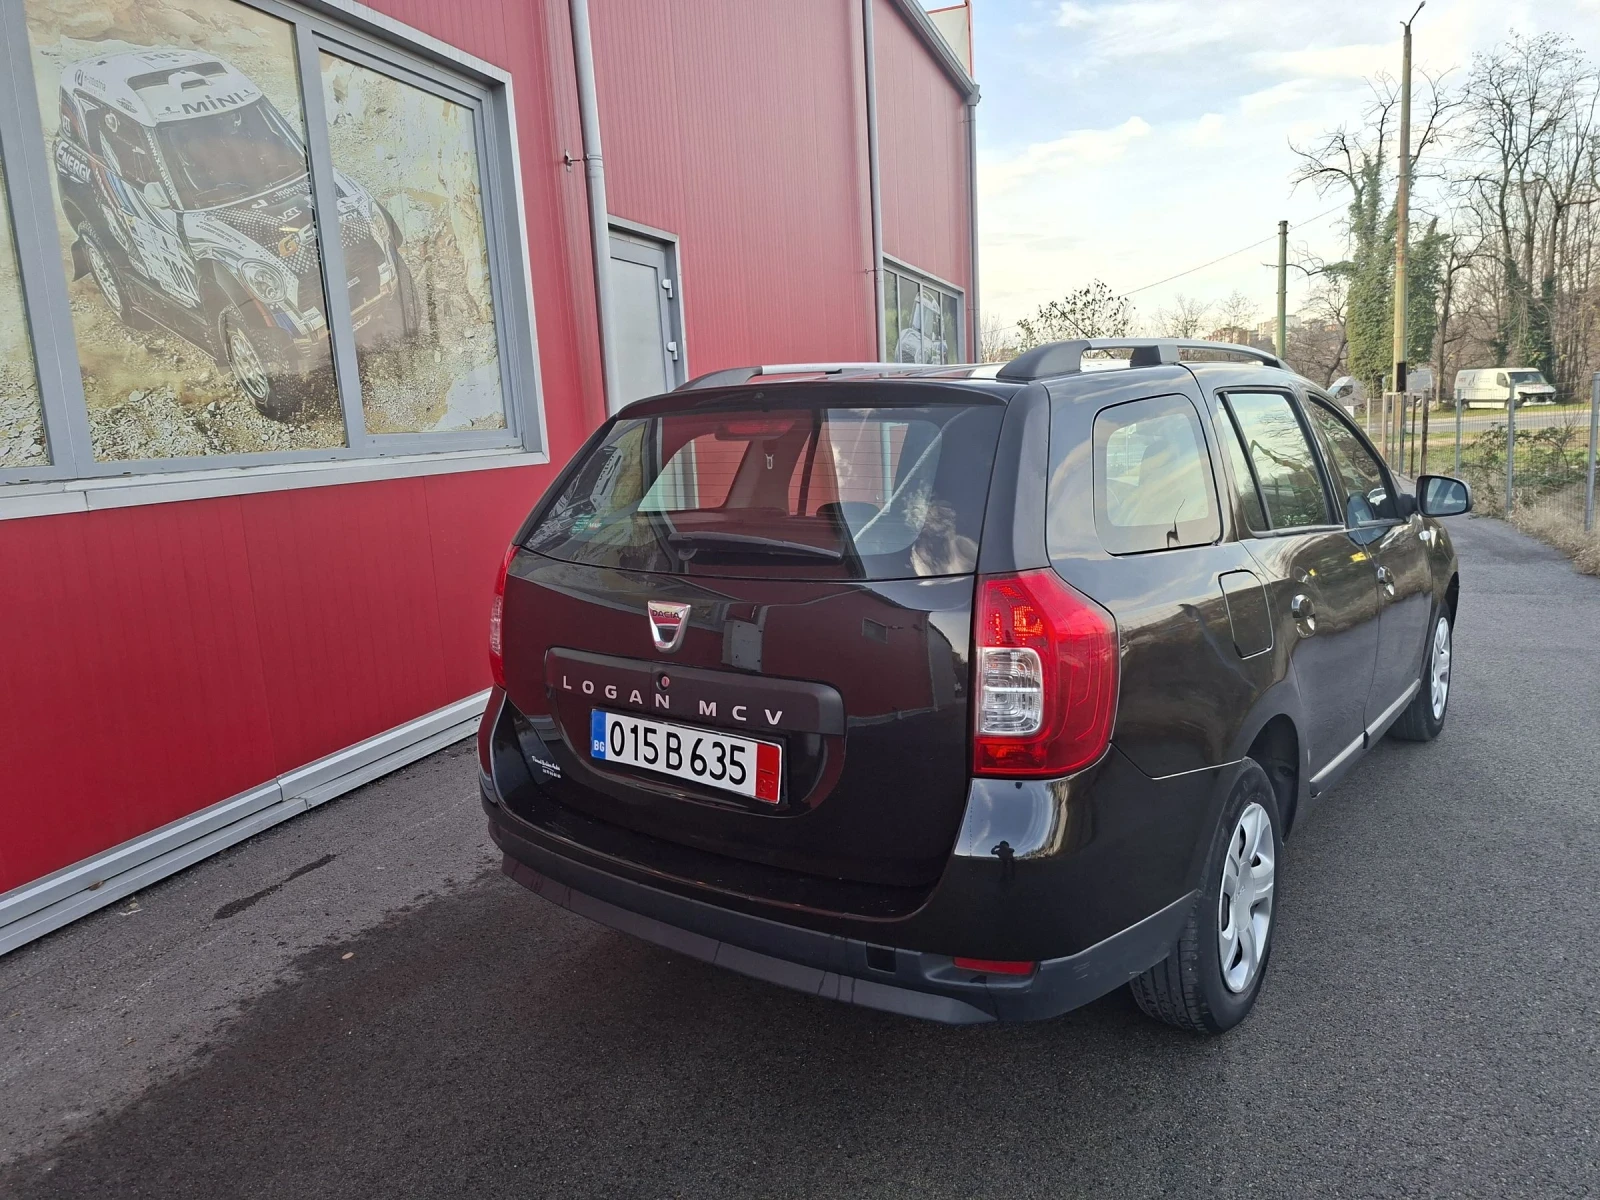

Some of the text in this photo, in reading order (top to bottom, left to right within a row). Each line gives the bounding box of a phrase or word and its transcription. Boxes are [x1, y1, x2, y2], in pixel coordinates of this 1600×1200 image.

[652, 609, 680, 619] DACIA
[562, 675, 783, 725] LOGAN MCV
[593, 739, 605, 752] BG
